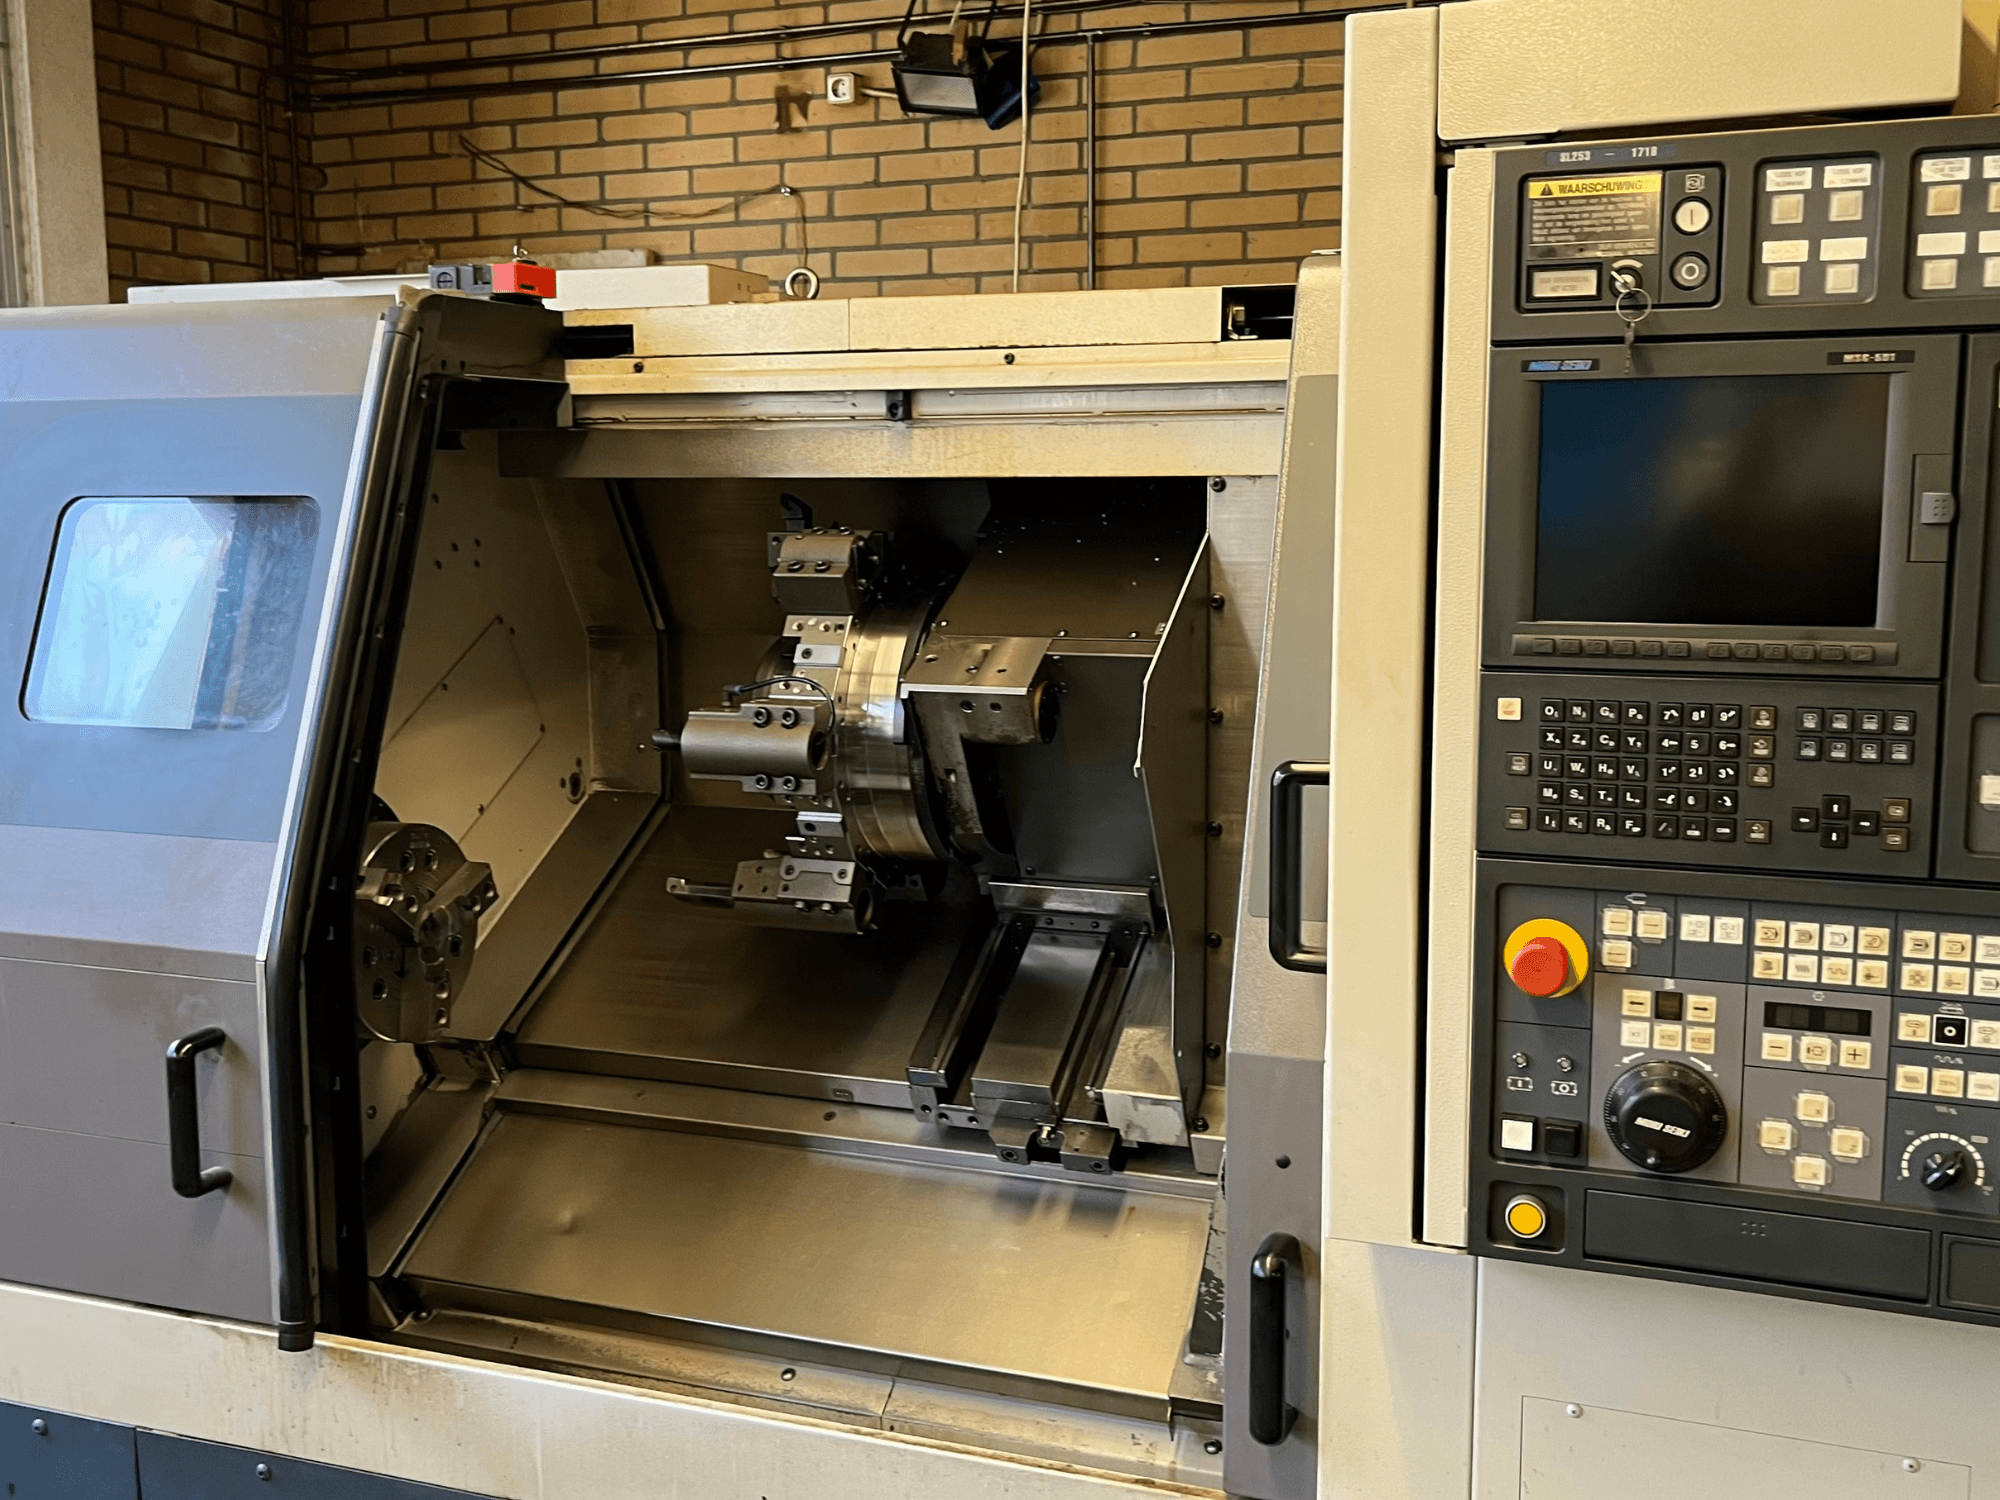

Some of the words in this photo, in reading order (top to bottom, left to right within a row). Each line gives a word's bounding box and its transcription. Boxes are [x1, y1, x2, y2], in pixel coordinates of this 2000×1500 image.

[1628, 708, 1638, 717] P
[1663, 711, 1671, 720] 7
[1692, 711, 1700, 721] 8
[1720, 712, 1728, 721] 9
[1661, 739, 1669, 747] 4
[1690, 740, 1699, 749] 5
[1719, 740, 1727, 750] 6
[1544, 761, 1552, 770] U
[1689, 768, 1697, 777] 2
[1718, 769, 1726, 778] 3
[1569, 789, 1579, 798] S
[1598, 791, 1606, 800] T
[1596, 818, 1605, 827] R
[1625, 820, 1634, 829] F
